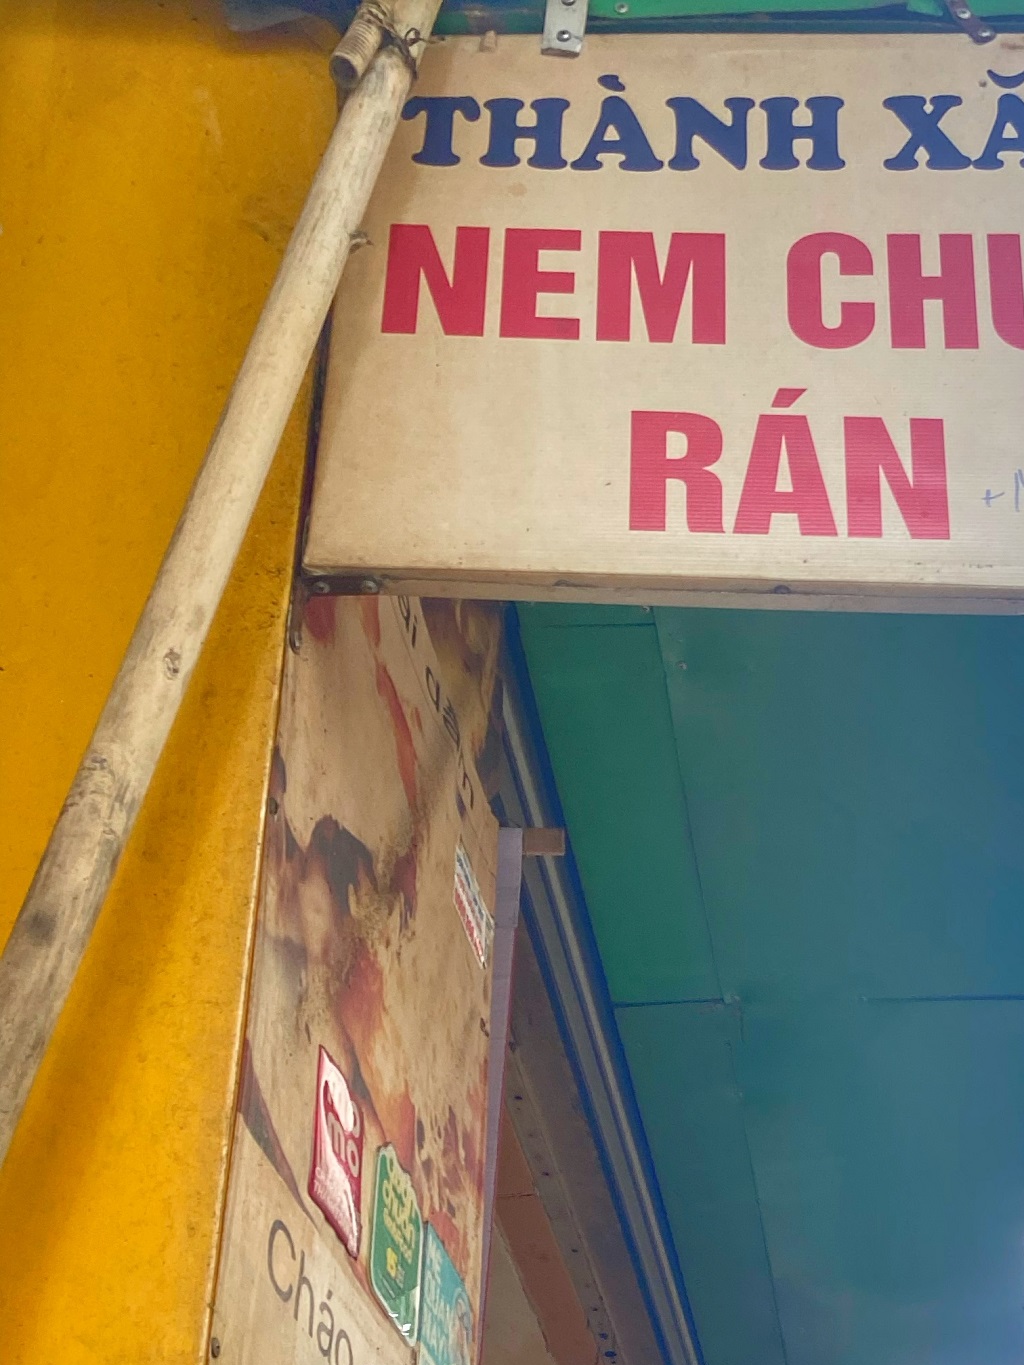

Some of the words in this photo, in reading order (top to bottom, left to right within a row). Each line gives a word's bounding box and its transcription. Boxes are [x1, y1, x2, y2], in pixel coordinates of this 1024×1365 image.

[401, 74, 846, 172] THÀNH
[380, 223, 727, 346] NEM
[628, 388, 952, 541] RÁN
